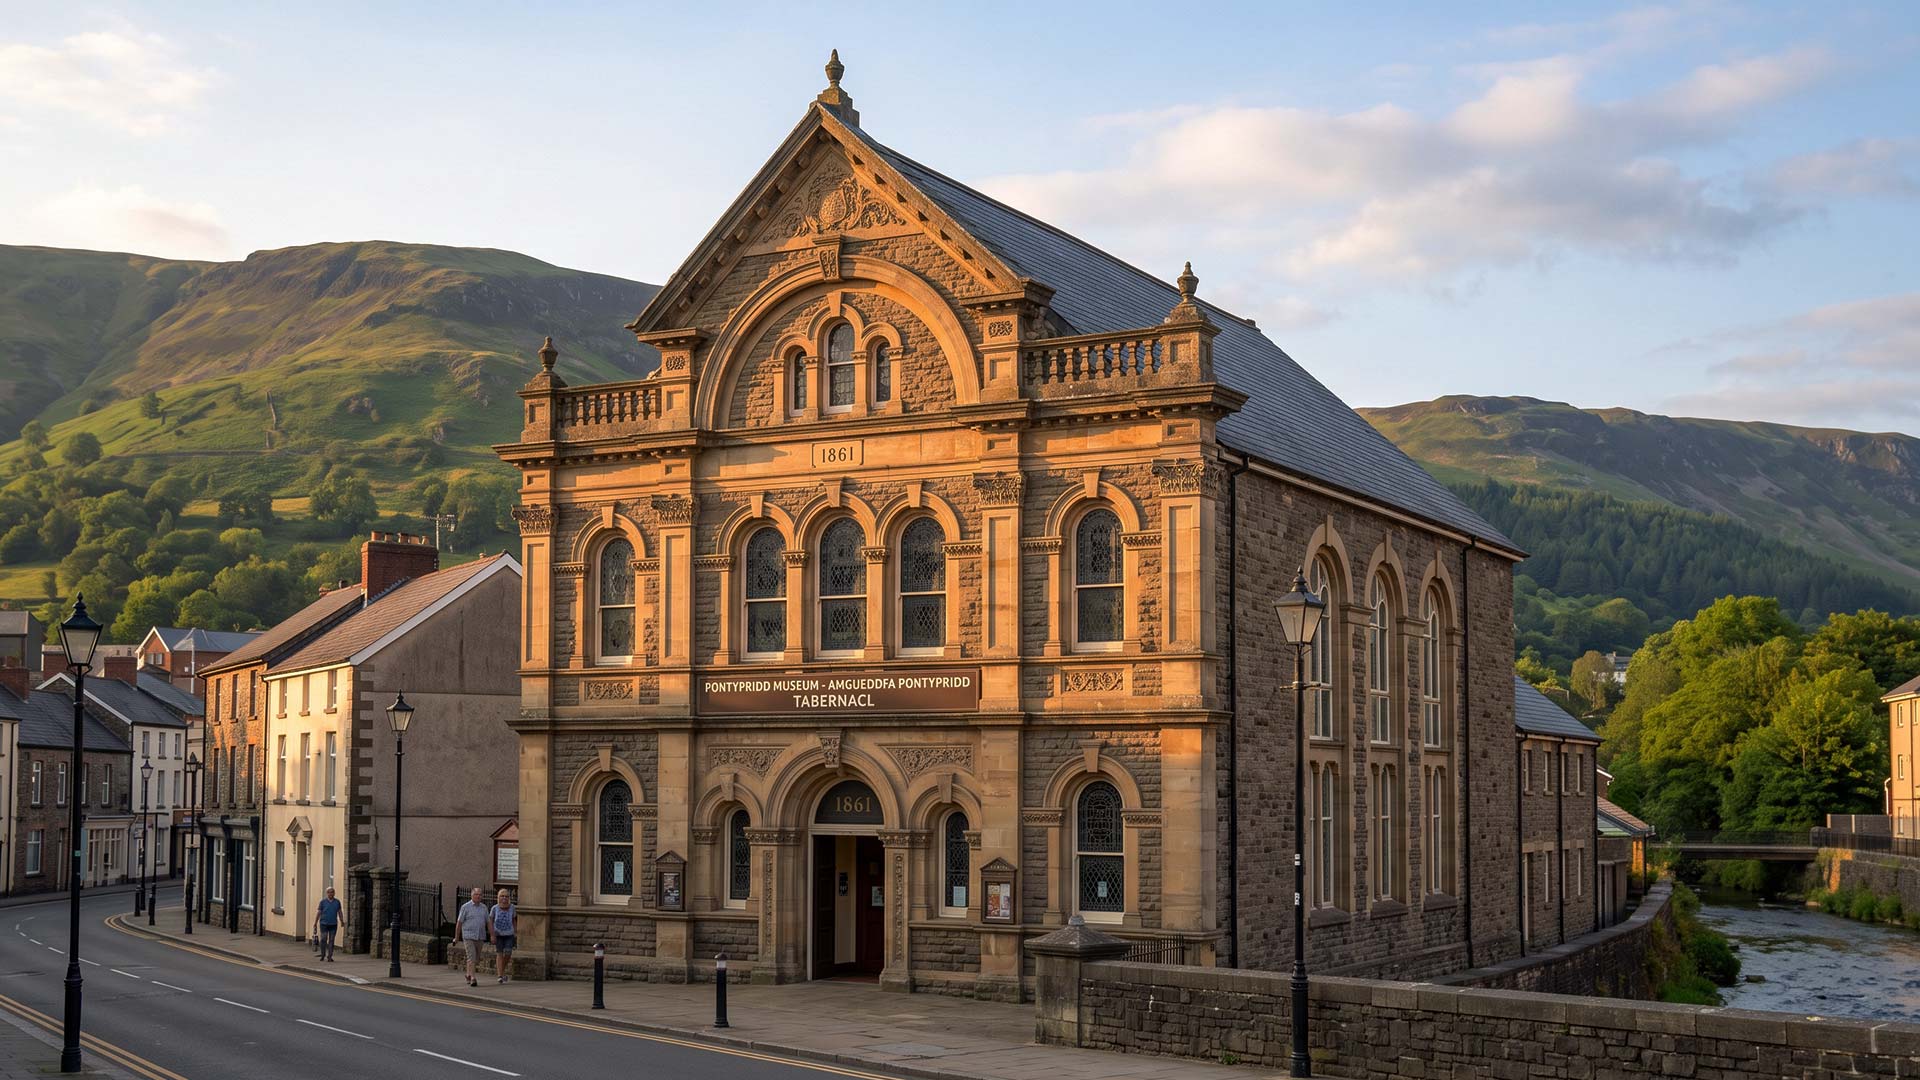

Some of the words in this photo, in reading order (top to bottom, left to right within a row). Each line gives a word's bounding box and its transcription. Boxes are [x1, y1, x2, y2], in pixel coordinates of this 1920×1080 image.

[822, 446, 853, 463] 1861
[705, 681, 771, 693] PONTYPRIDD
[773, 680, 819, 691] MUSEUM
[828, 678, 896, 690] AMGUEDDFA
[898, 676, 970, 689] PONTYPRIDD
[793, 694, 875, 708] TABERNACL
[836, 796, 871, 813] 1861
